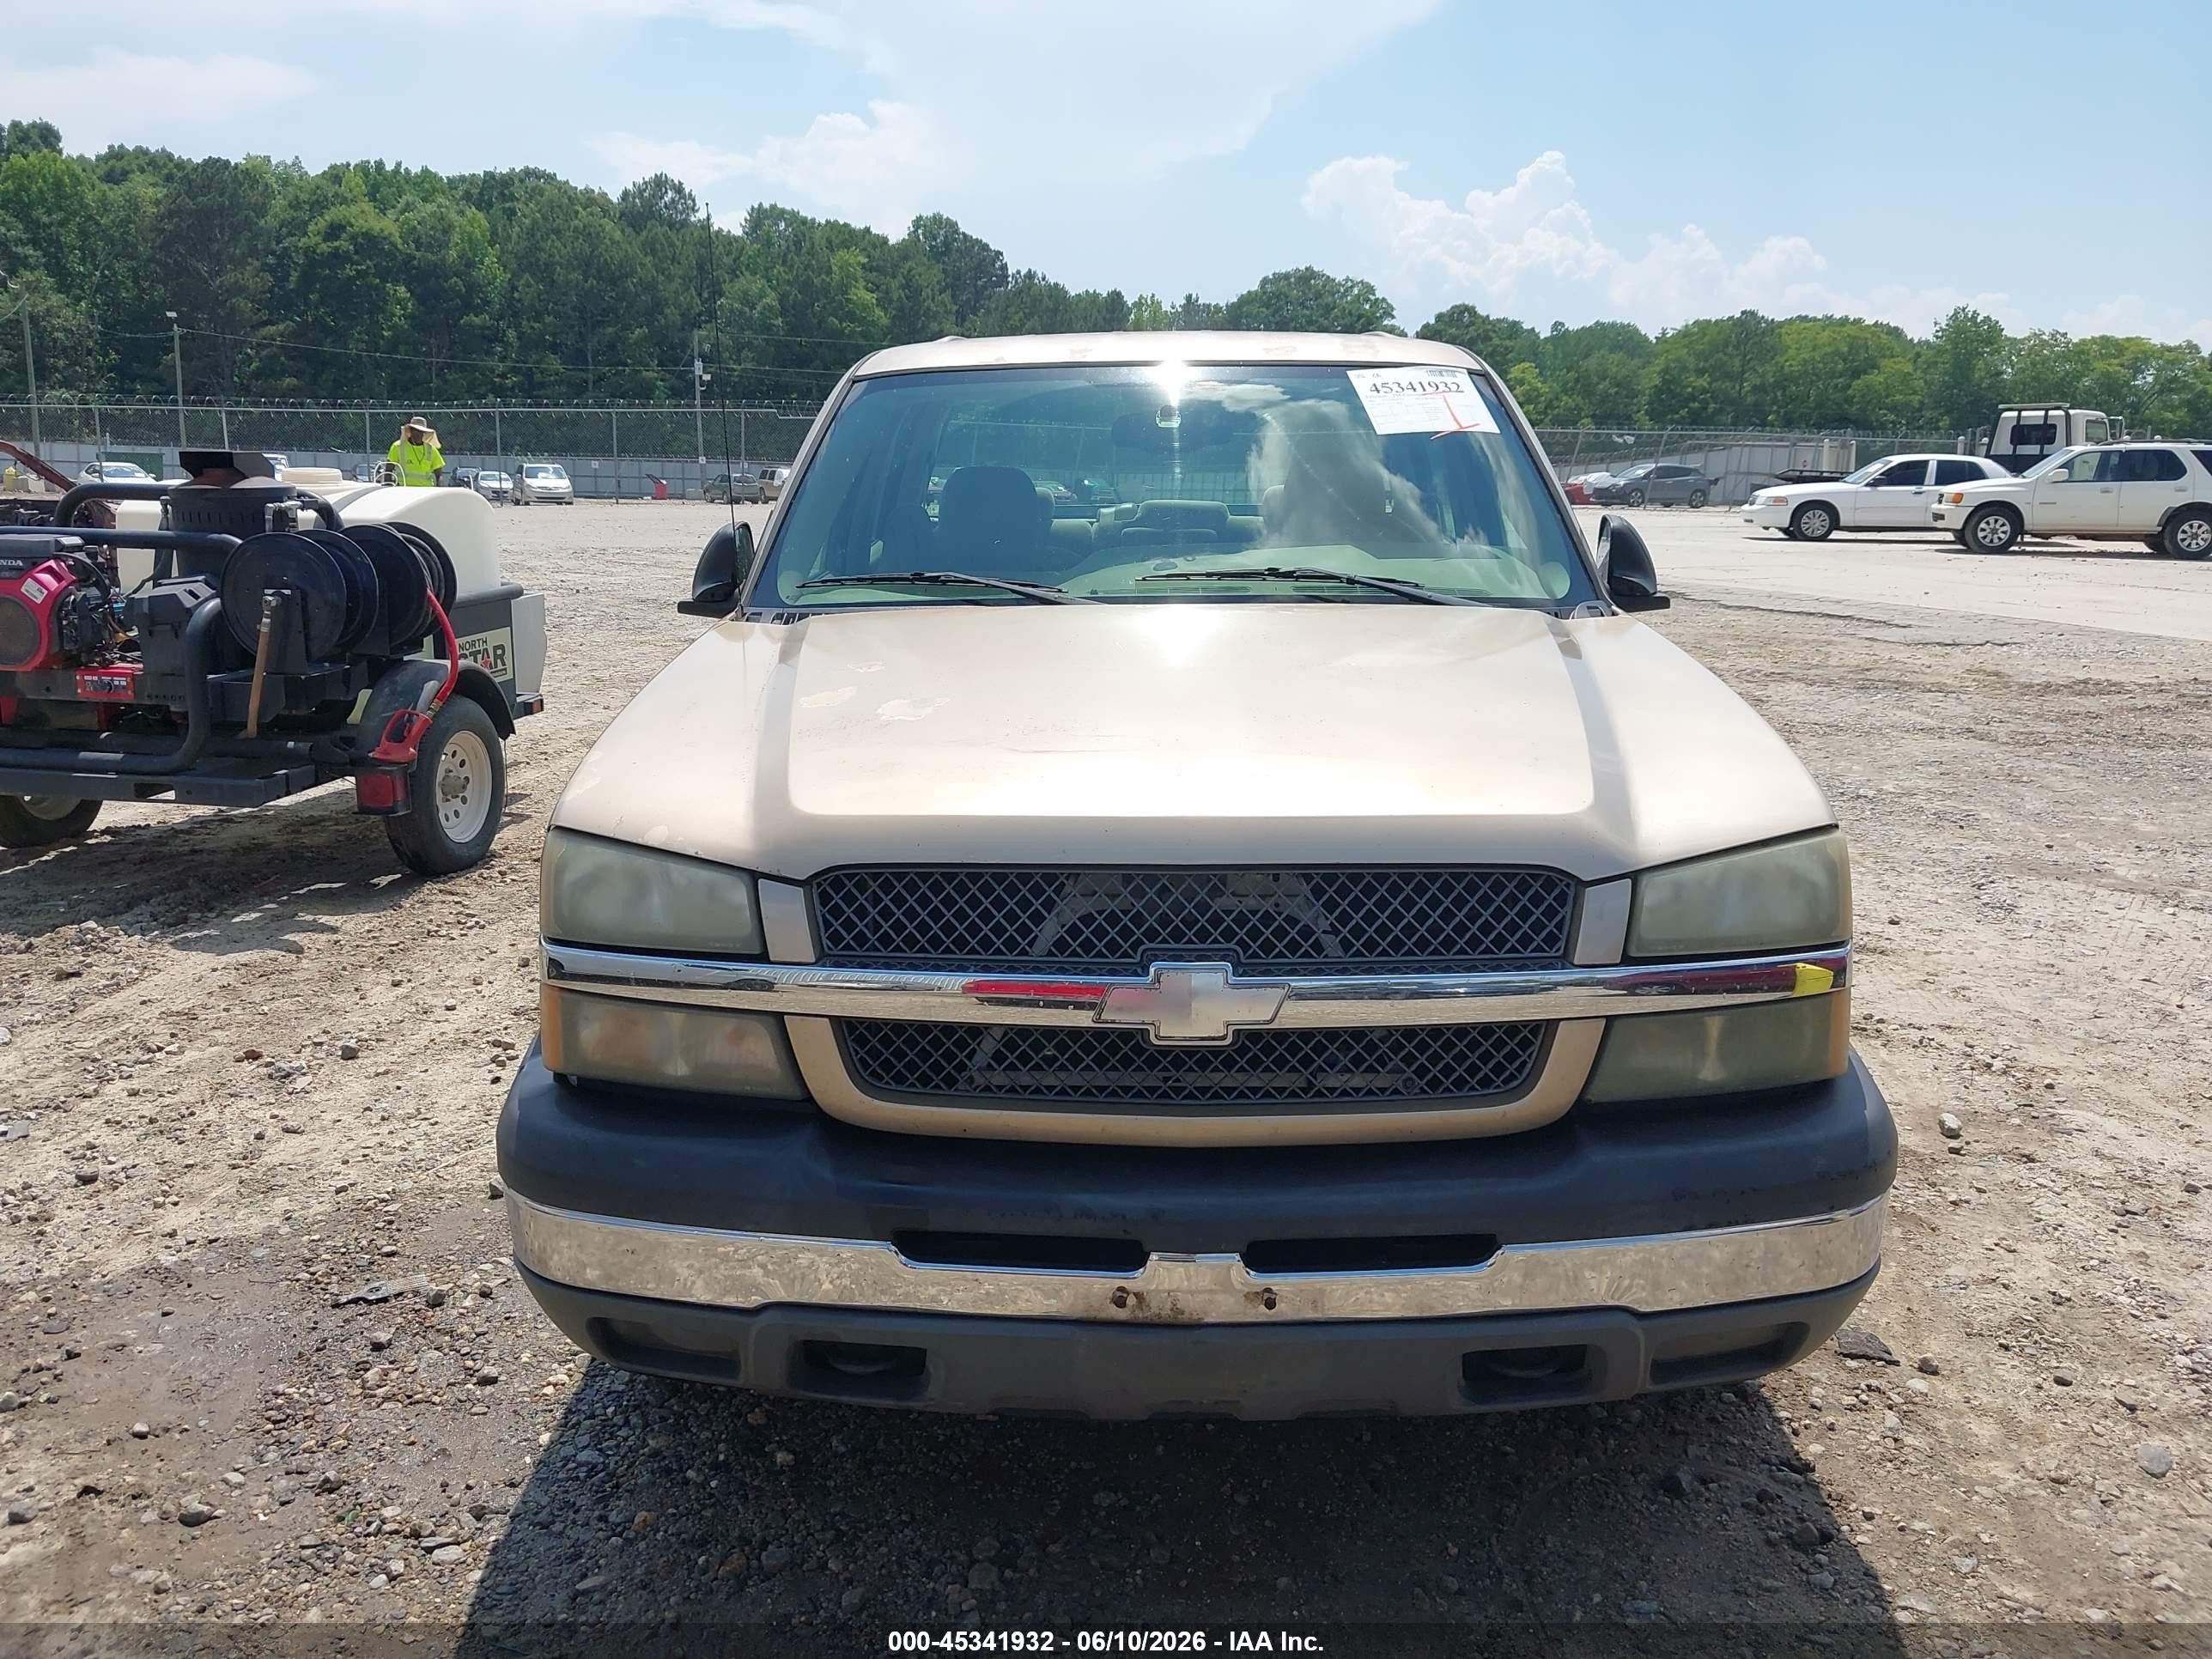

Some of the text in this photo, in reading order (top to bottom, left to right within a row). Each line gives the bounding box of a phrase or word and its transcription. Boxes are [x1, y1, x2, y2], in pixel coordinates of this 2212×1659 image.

[1370, 381, 1464, 393] 45341932
[458, 636, 488, 653] NORTH
[459, 643, 507, 671] TAR
